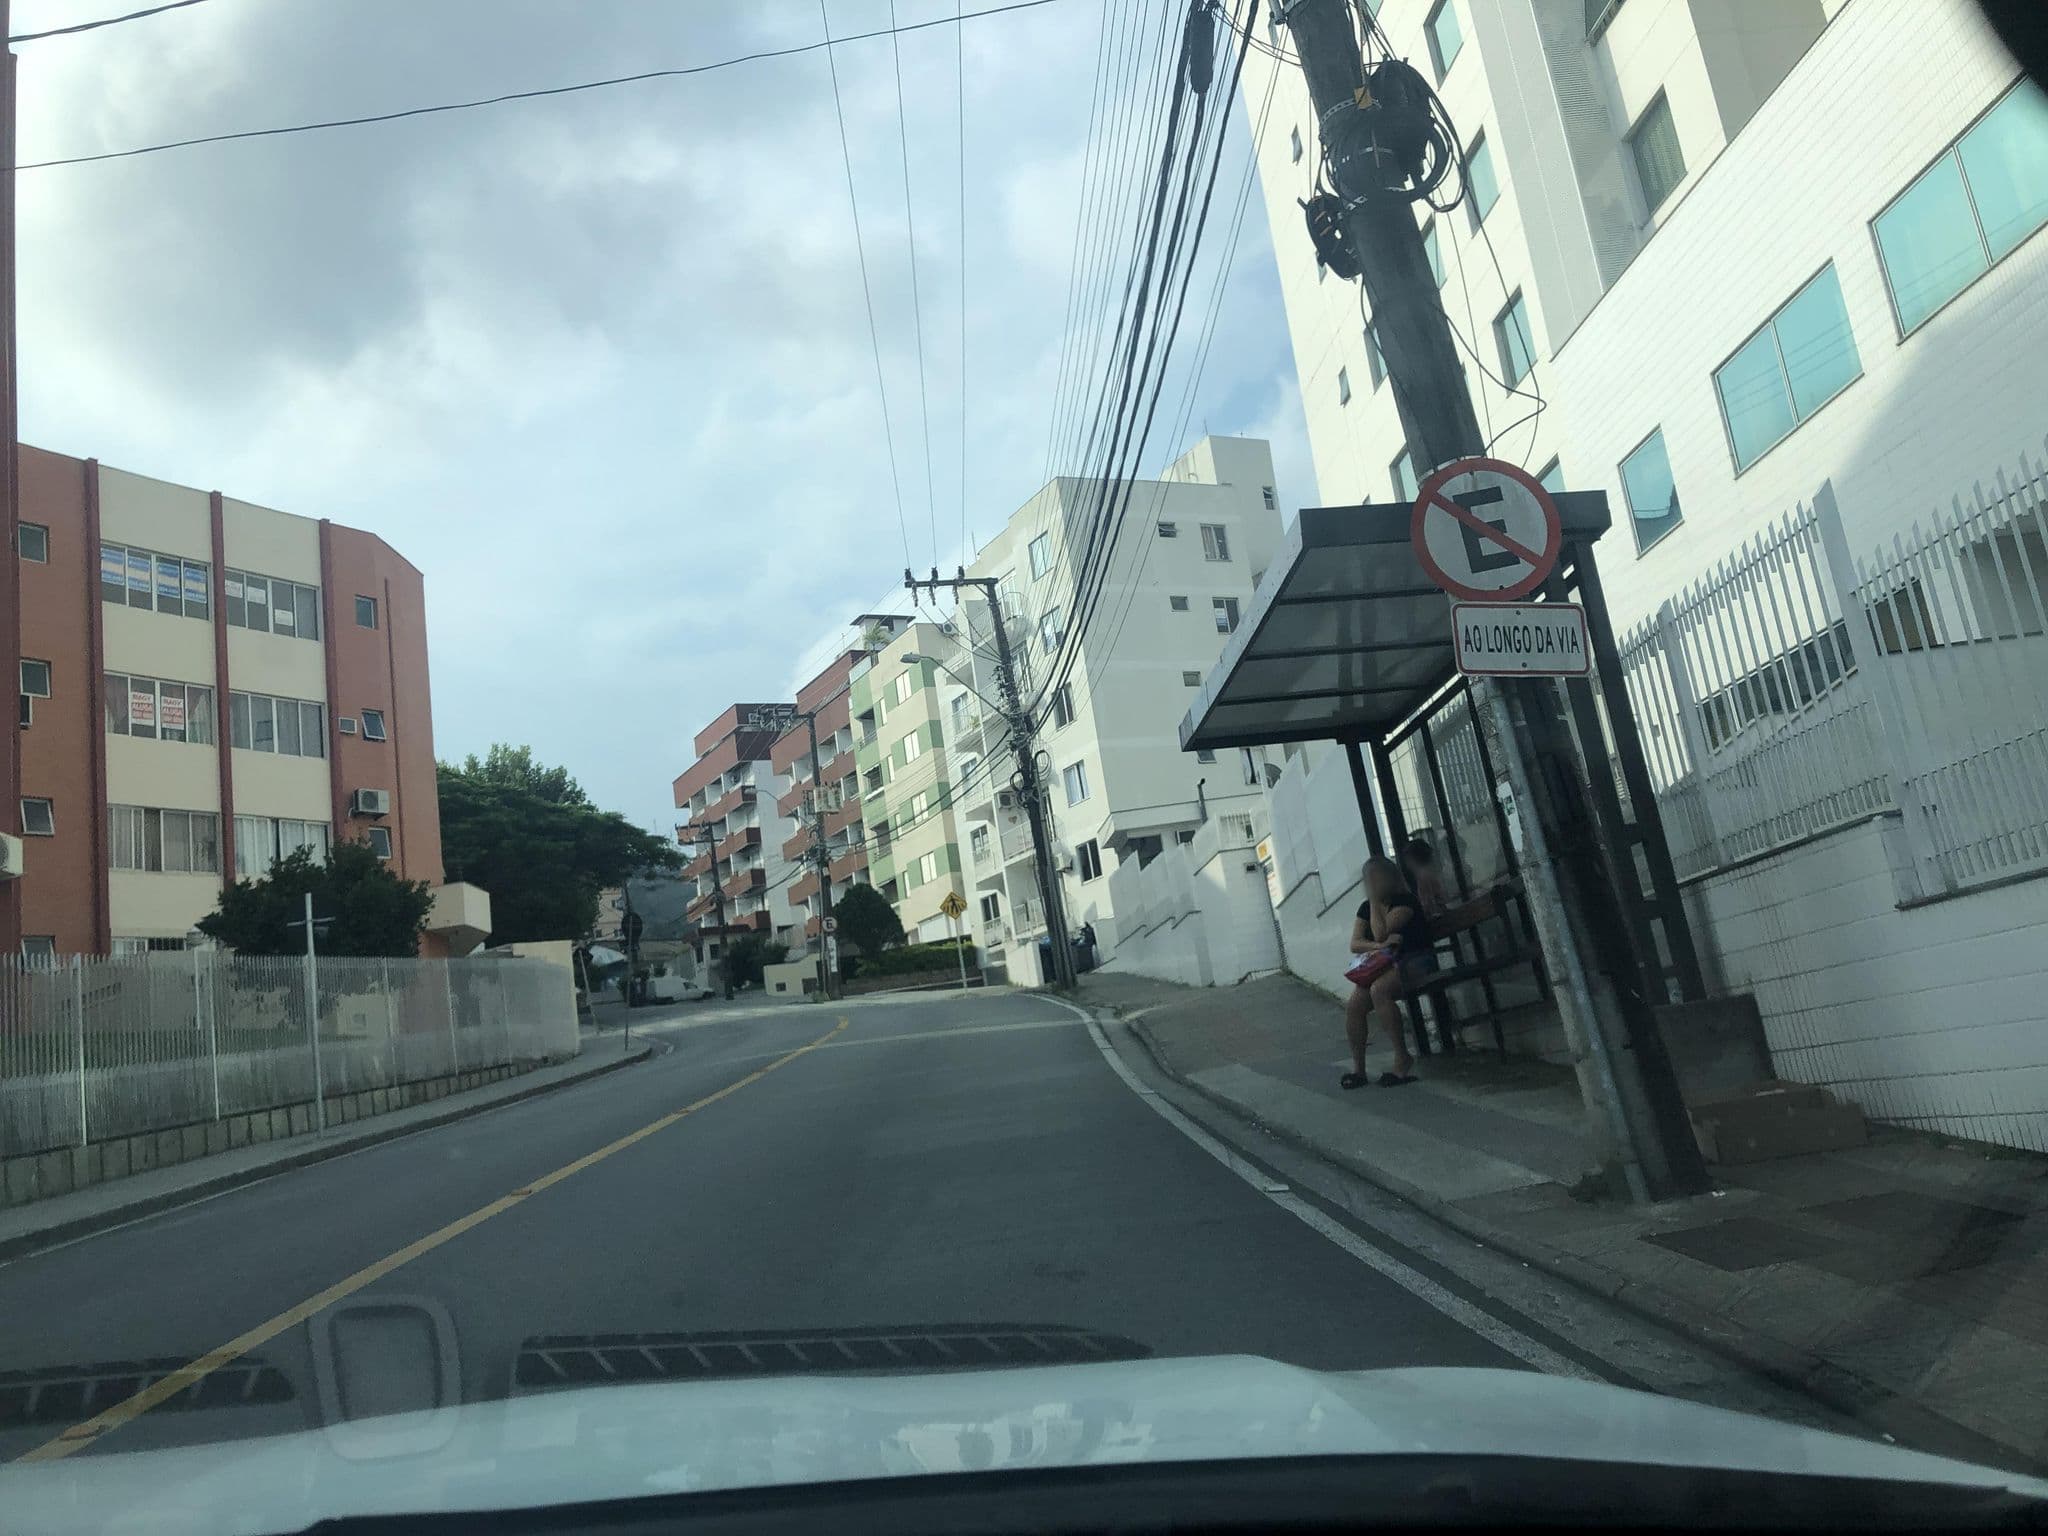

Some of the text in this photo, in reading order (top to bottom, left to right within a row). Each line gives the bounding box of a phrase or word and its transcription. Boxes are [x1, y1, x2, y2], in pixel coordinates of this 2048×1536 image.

[1452, 486, 1521, 574] E
[1464, 624, 1580, 653] AO LONGO DA VIA
